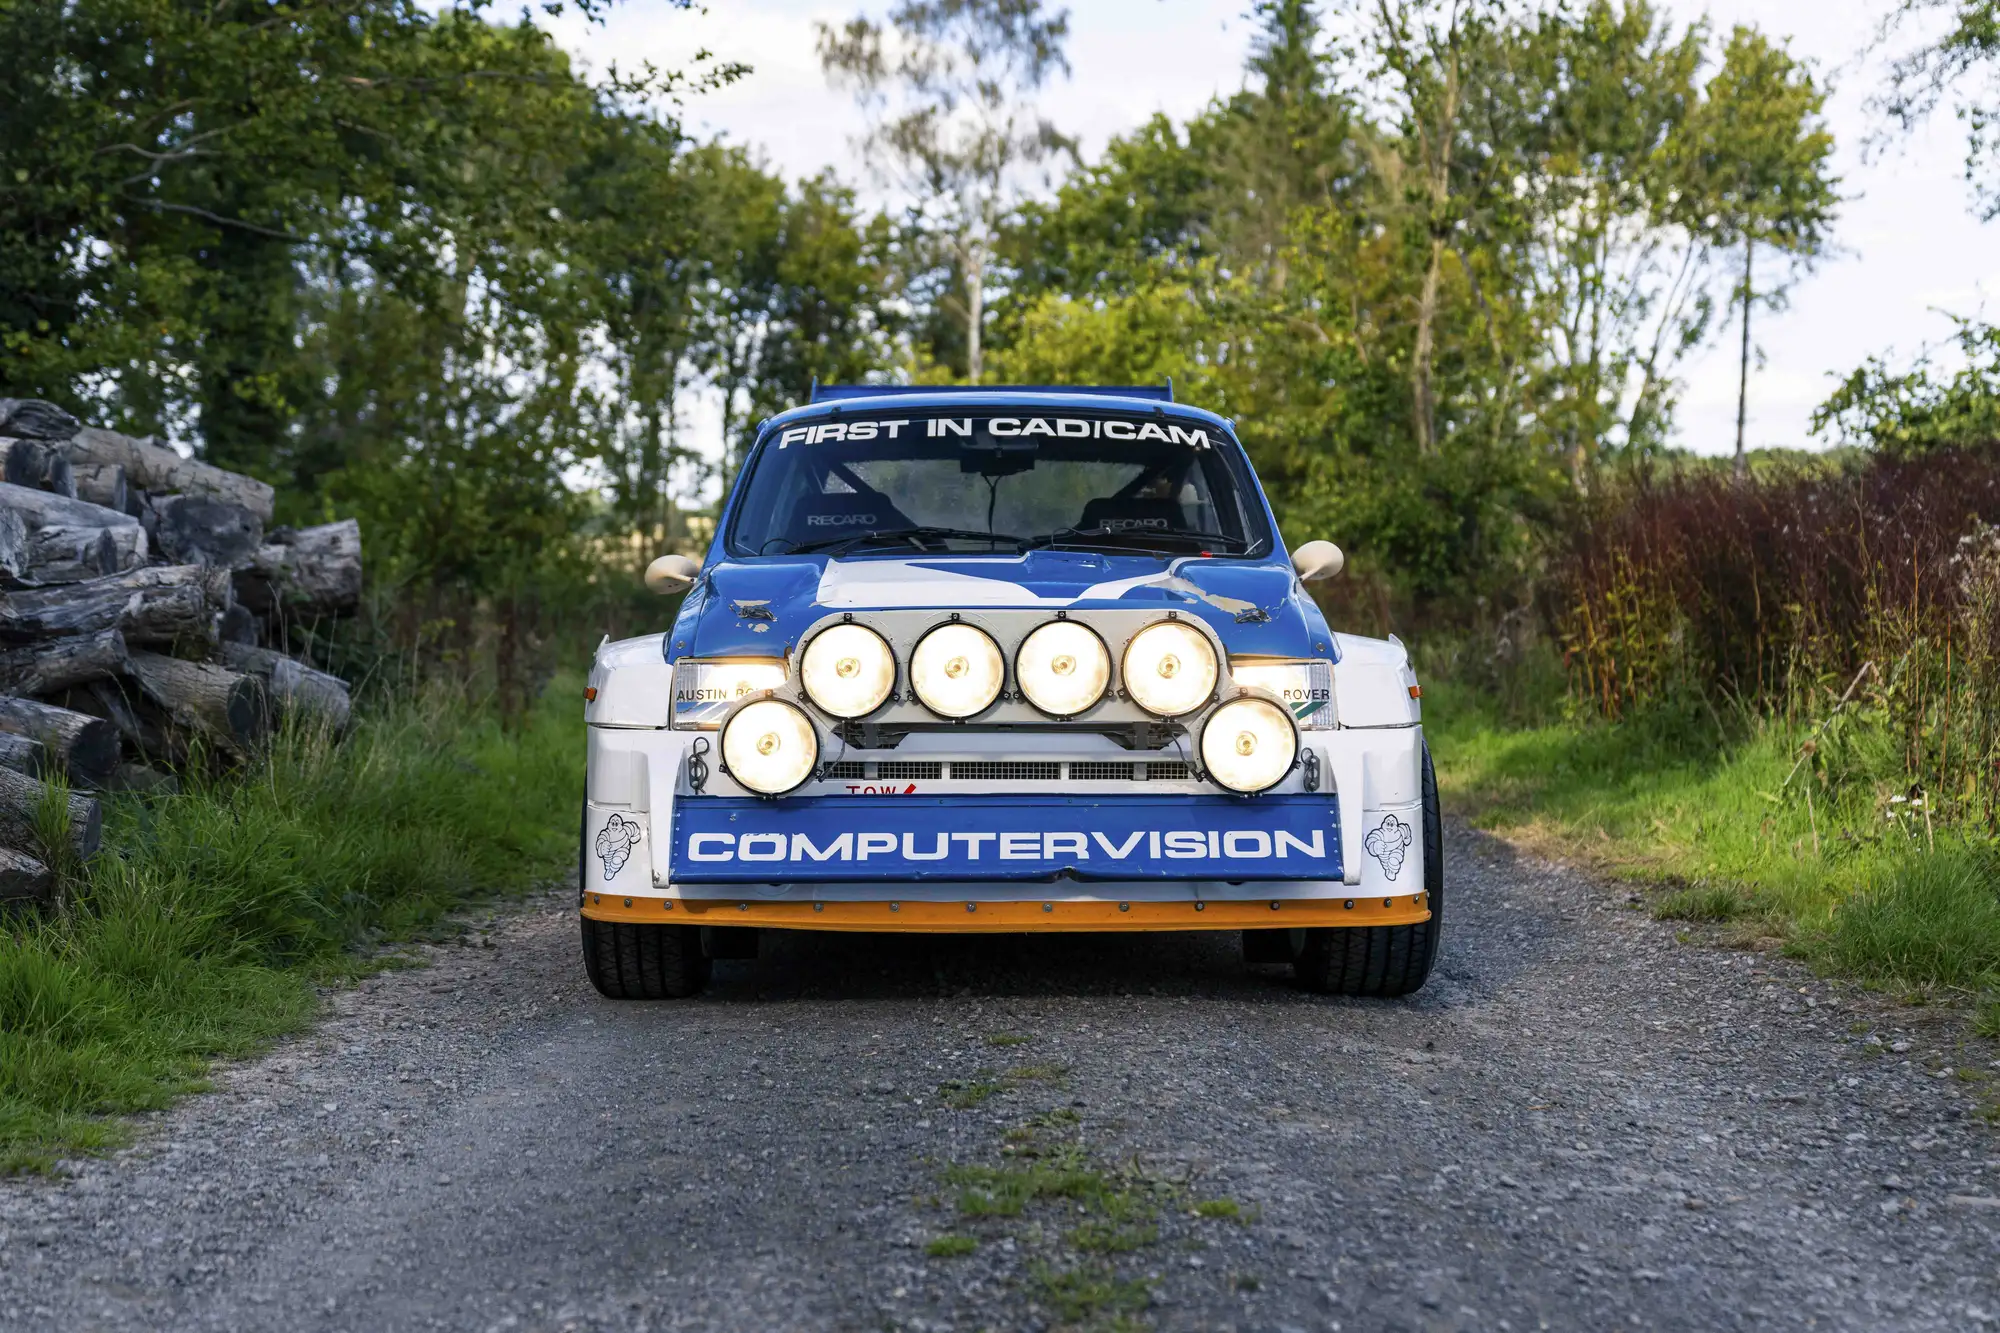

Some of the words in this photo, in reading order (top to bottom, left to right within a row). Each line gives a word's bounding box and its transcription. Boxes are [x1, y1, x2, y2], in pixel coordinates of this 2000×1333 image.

[778, 419, 910, 449] FIRST
[927, 417, 973, 437] IN
[807, 513, 877, 526] RECARO
[1099, 518, 1168, 530] RECARO
[676, 689, 727, 701] AUSTIN
[1283, 689, 1330, 700] ROVER
[687, 830, 1326, 862] COMPUTERVISION
